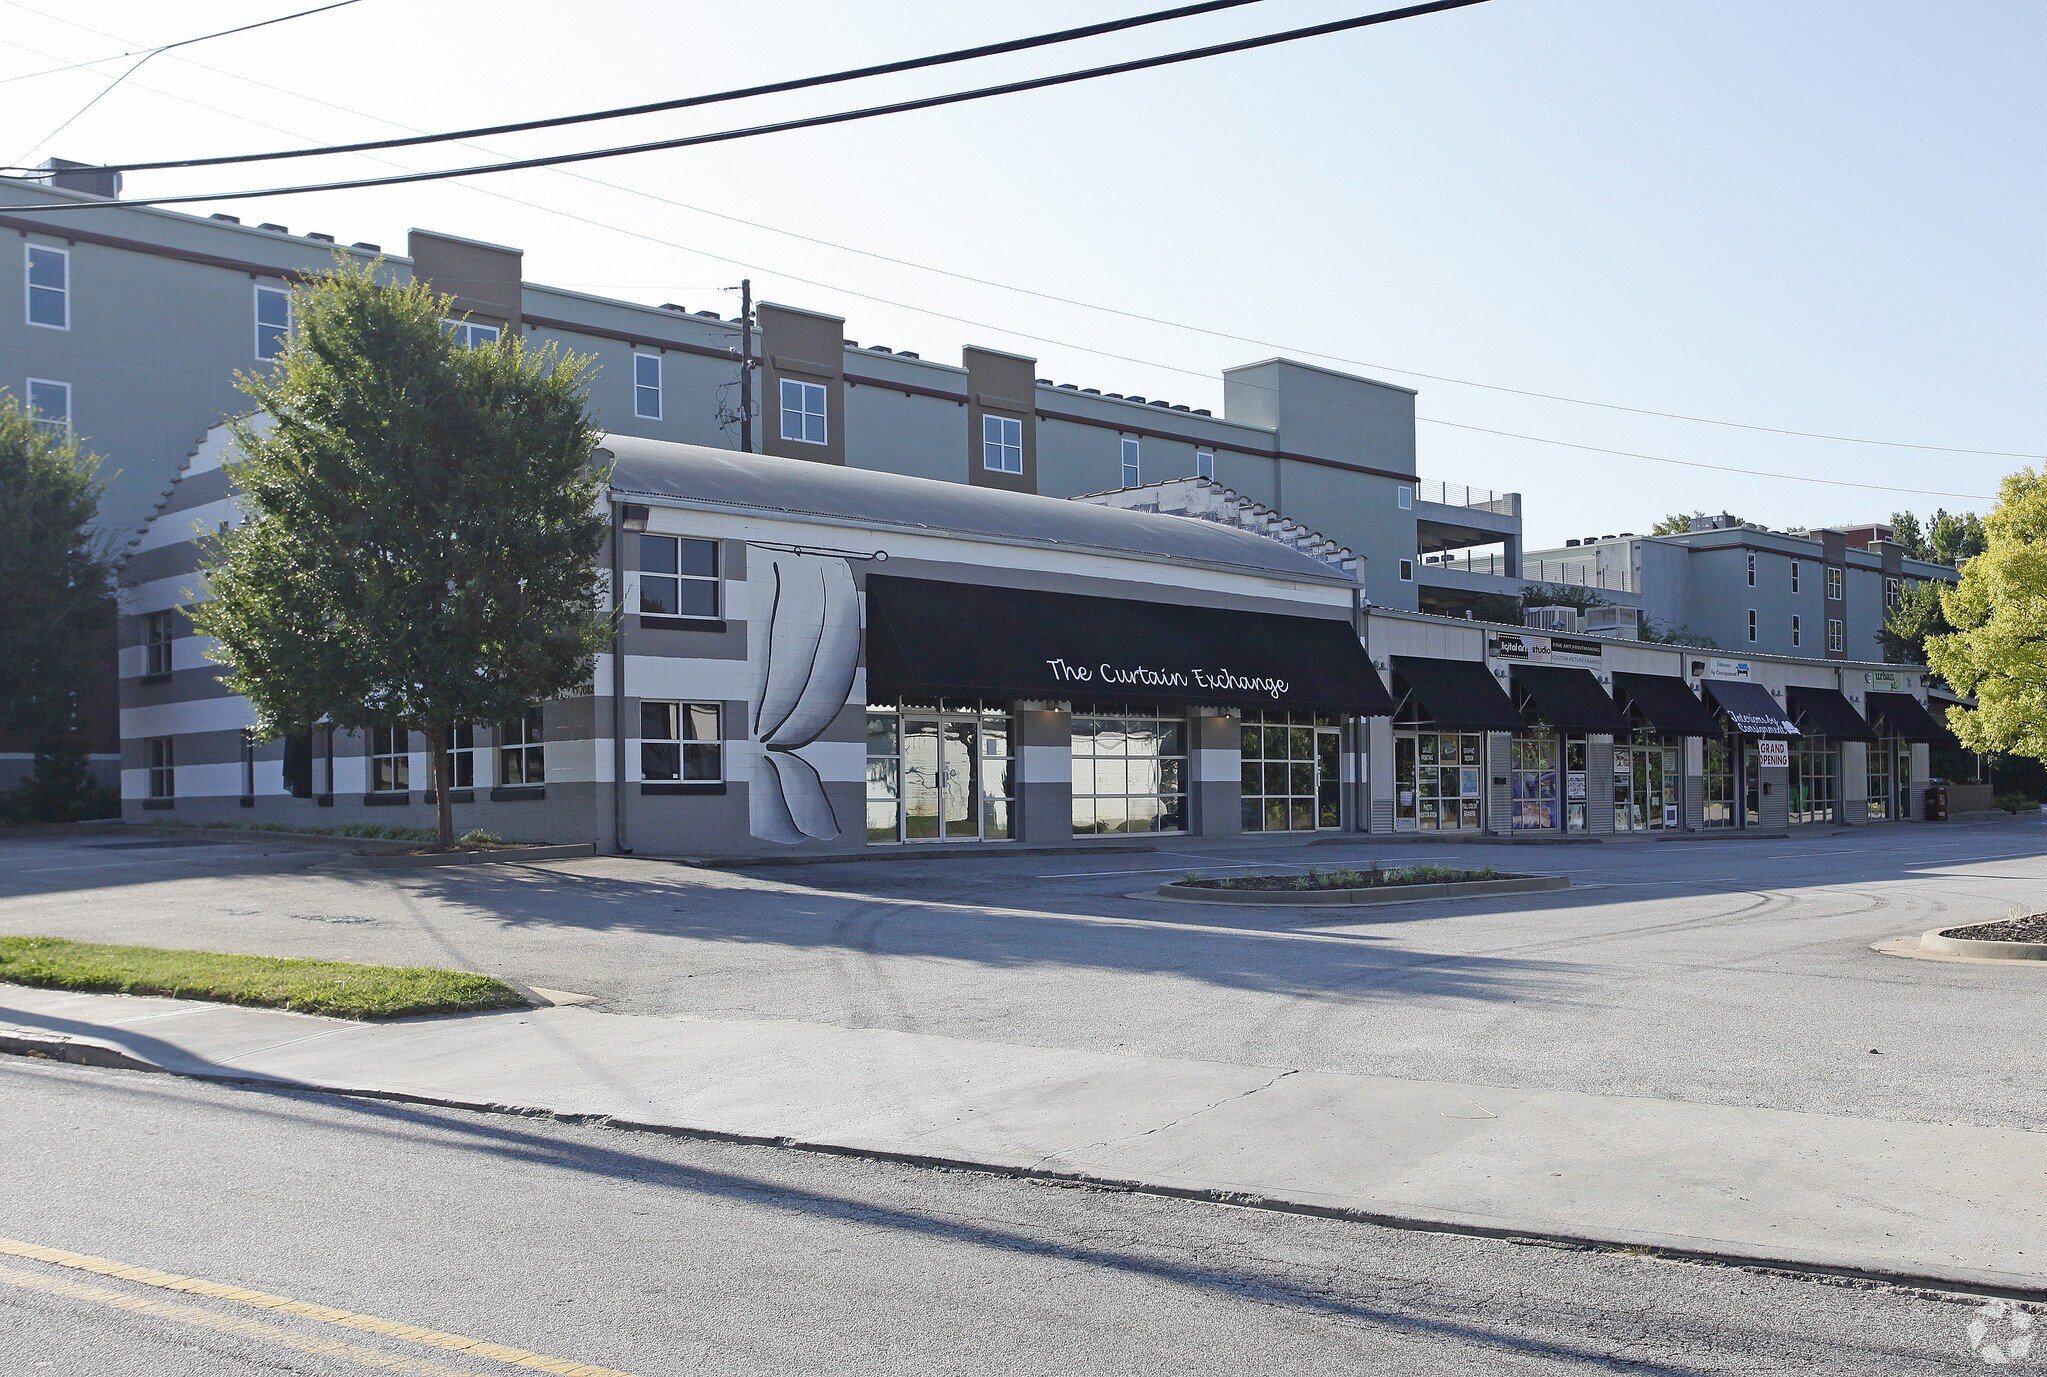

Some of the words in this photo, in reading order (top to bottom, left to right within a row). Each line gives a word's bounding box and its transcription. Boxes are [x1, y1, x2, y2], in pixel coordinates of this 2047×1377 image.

[1572, 645, 1600, 653] PRINTMAKING
[1046, 658, 1093, 682] The
[1100, 663, 1188, 687] Curtain
[1191, 668, 1289, 699] Exchange
[1875, 671, 1894, 681] urban
[1727, 710, 1767, 724] Interiors
[1738, 722, 1787, 735] Consignment
[1761, 743, 1784, 753] GRAND
